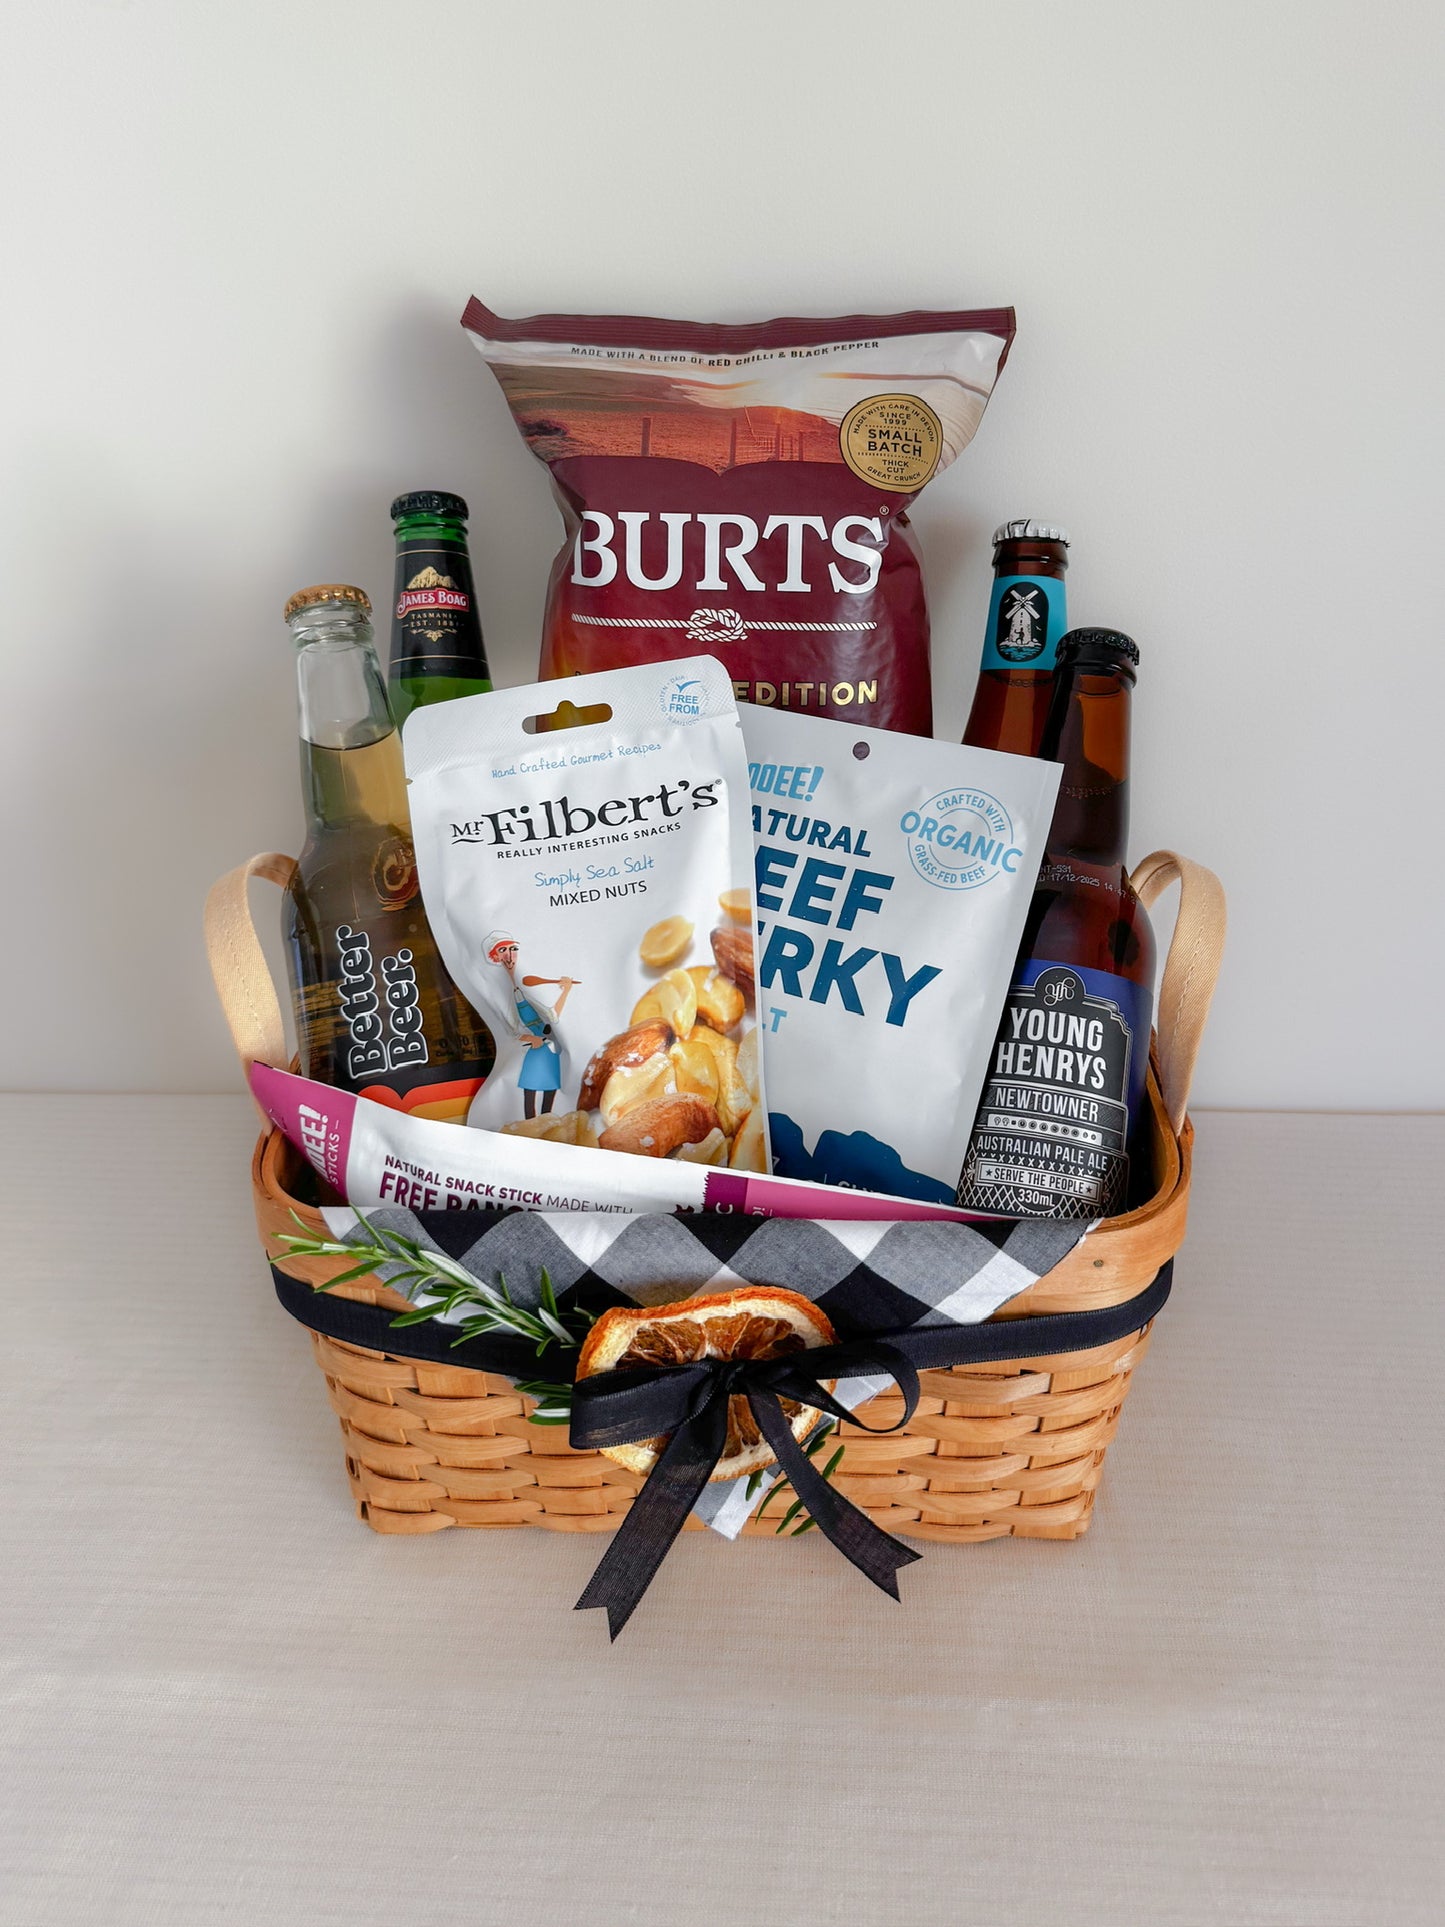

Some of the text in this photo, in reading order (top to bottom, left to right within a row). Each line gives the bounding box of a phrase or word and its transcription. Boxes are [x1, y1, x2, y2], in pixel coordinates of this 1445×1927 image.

[571, 347, 601, 358] MADE
[606, 351, 635, 359] WITH
[649, 354, 686, 363] BLEND
[690, 357, 702, 365] OF
[708, 358, 731, 367] RED
[735, 353, 774, 366] CHILLI
[777, 351, 786, 359] &
[790, 347, 829, 359] BLACK
[833, 341, 879, 352] PEPPER
[853, 403, 935, 442] MADE WITH CARE IN DEVON
[879, 411, 911, 420] SINCE
[884, 418, 907, 426] 1999
[867, 441, 922, 457] BATCH
[868, 428, 922, 444] SMALL
[867, 465, 921, 482] GREAT CRUNCH
[882, 459, 909, 468] THICK
[886, 466, 905, 474] CUT
[571, 510, 886, 594] BURTS
[396, 590, 467, 614] JAMES BOAG
[669, 703, 700, 715] FROM
[671, 693, 699, 704] FREE
[731, 680, 878, 706] EDITION
[492, 742, 662, 779] Hand Crafted Gourmet Recipes
[748, 762, 825, 802] OOEE!
[450, 779, 720, 846] Mr Filbert's
[751, 804, 872, 858] ATURAL
[935, 793, 1006, 832] CRAFTED WITH
[497, 821, 682, 860] REALLY INTERESTING SNACKS
[900, 811, 1024, 873] ORGANIC
[534, 855, 655, 889] Simply Sea Salt
[914, 844, 986, 884] GRASS-FED BEEF
[549, 880, 648, 907] MIXED NUTS
[754, 845, 895, 931] EEF
[757, 920, 944, 1028] RKY
[335, 924, 388, 1079] Better
[380, 948, 429, 1071] Beer.
[1010, 1007, 1104, 1051] YOUNG
[995, 1041, 1108, 1089] HENRYS
[994, 1086, 1099, 1123] NEWTOWNER
[976, 1135, 1108, 1172] AUSTRALIAN PALE ALE
[378, 1170, 438, 1212] FREE
[385, 1154, 441, 1186] NATURAL
[445, 1176, 496, 1198] SNACK
[498, 1187, 543, 1205] STICK
[546, 1194, 591, 1212] MADE
[993, 1167, 1084, 1194] SERVE THE PEOPLE
[1017, 1188, 1056, 1207] 330mL
